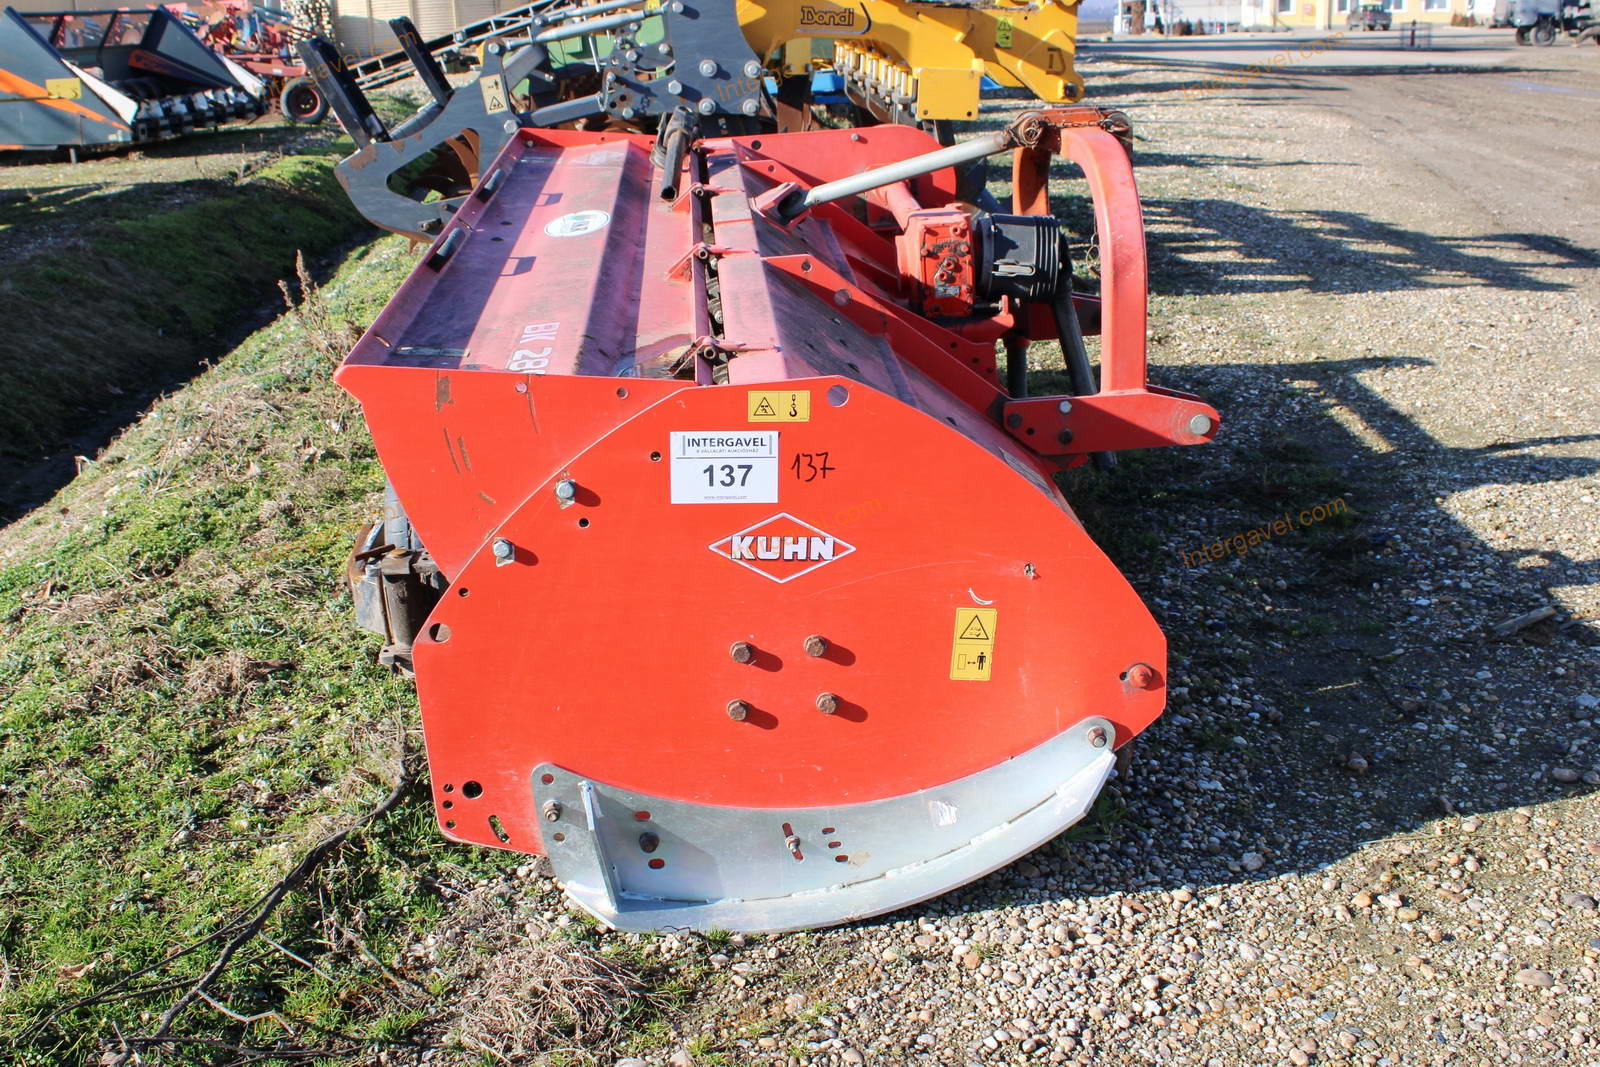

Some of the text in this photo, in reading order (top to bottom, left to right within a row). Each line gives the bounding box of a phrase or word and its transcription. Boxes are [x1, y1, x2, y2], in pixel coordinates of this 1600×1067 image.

[801, 6, 855, 27] Dondi
[506, 321, 561, 374] BK 28
[687, 437, 767, 447] INTERGAVEL
[703, 464, 753, 487] 137
[790, 451, 836, 482] 137
[730, 535, 836, 562] KUHN
